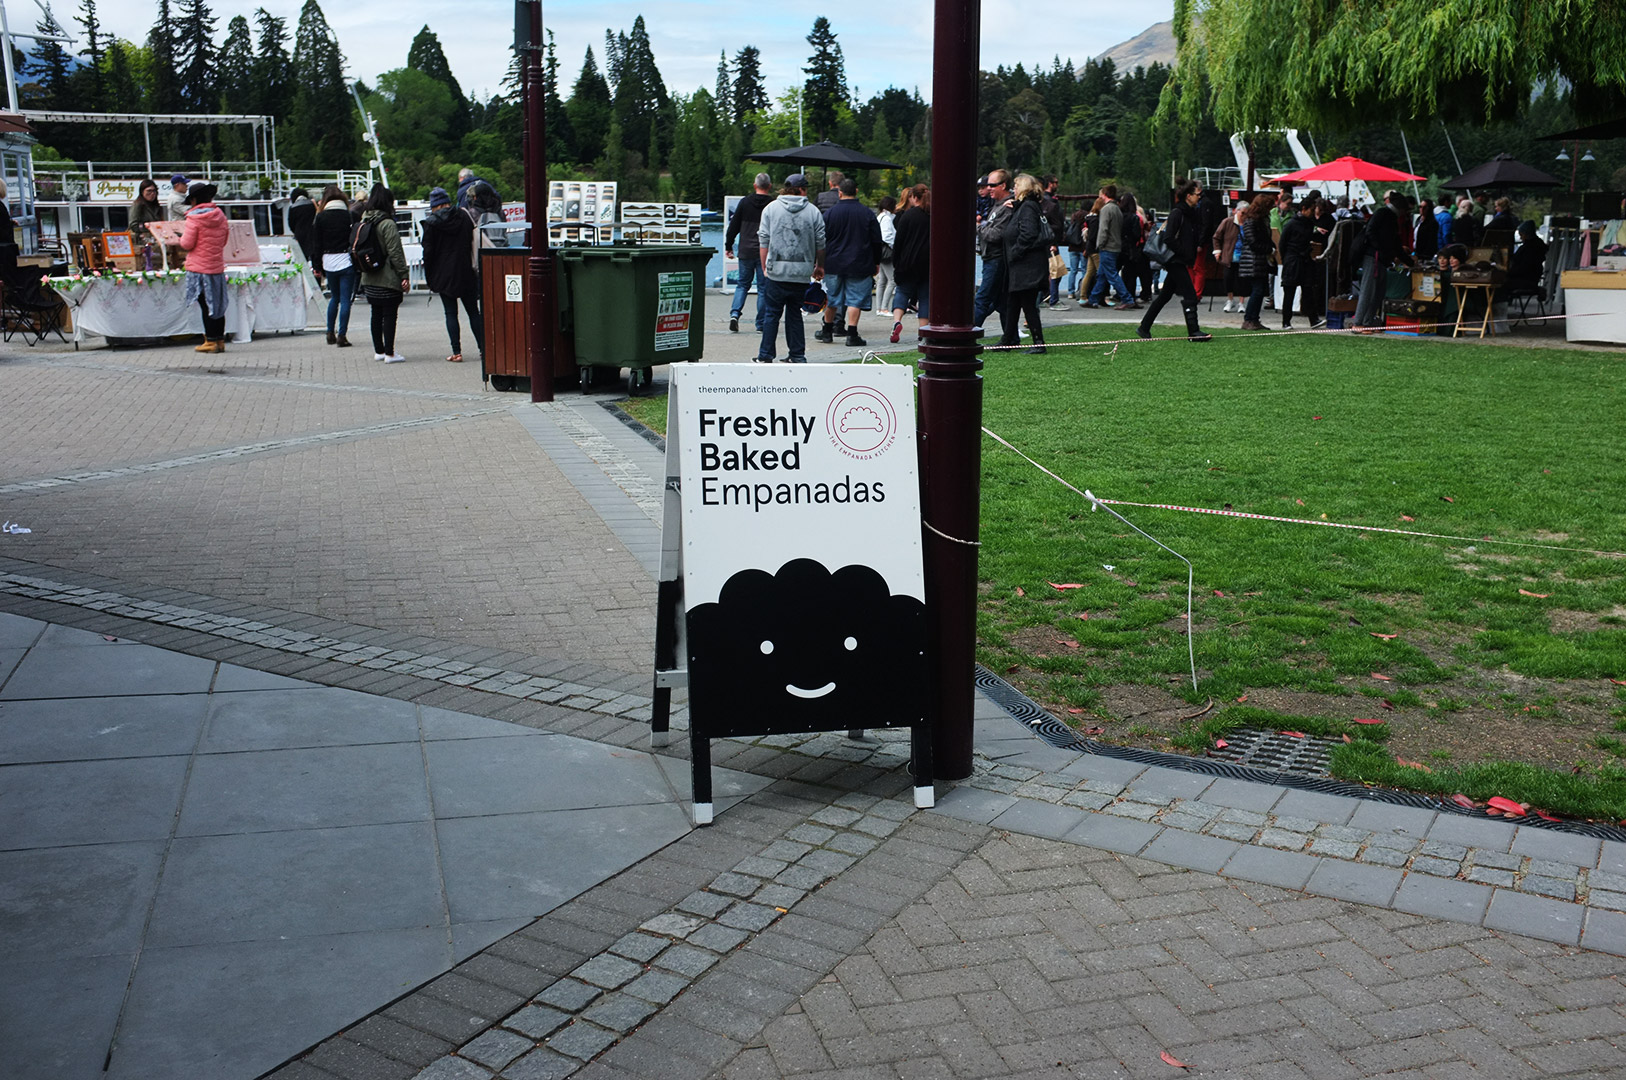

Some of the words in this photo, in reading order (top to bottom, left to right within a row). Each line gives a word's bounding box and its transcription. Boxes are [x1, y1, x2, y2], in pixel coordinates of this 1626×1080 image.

[503, 207, 525, 217] OPEN
[699, 408, 816, 444] Freshly
[700, 441, 801, 471] Baked
[829, 435, 839, 447] THE
[838, 447, 873, 461] EMPANADA
[874, 435, 896, 457] KITCHEN
[702, 474, 886, 513] Empanadas
